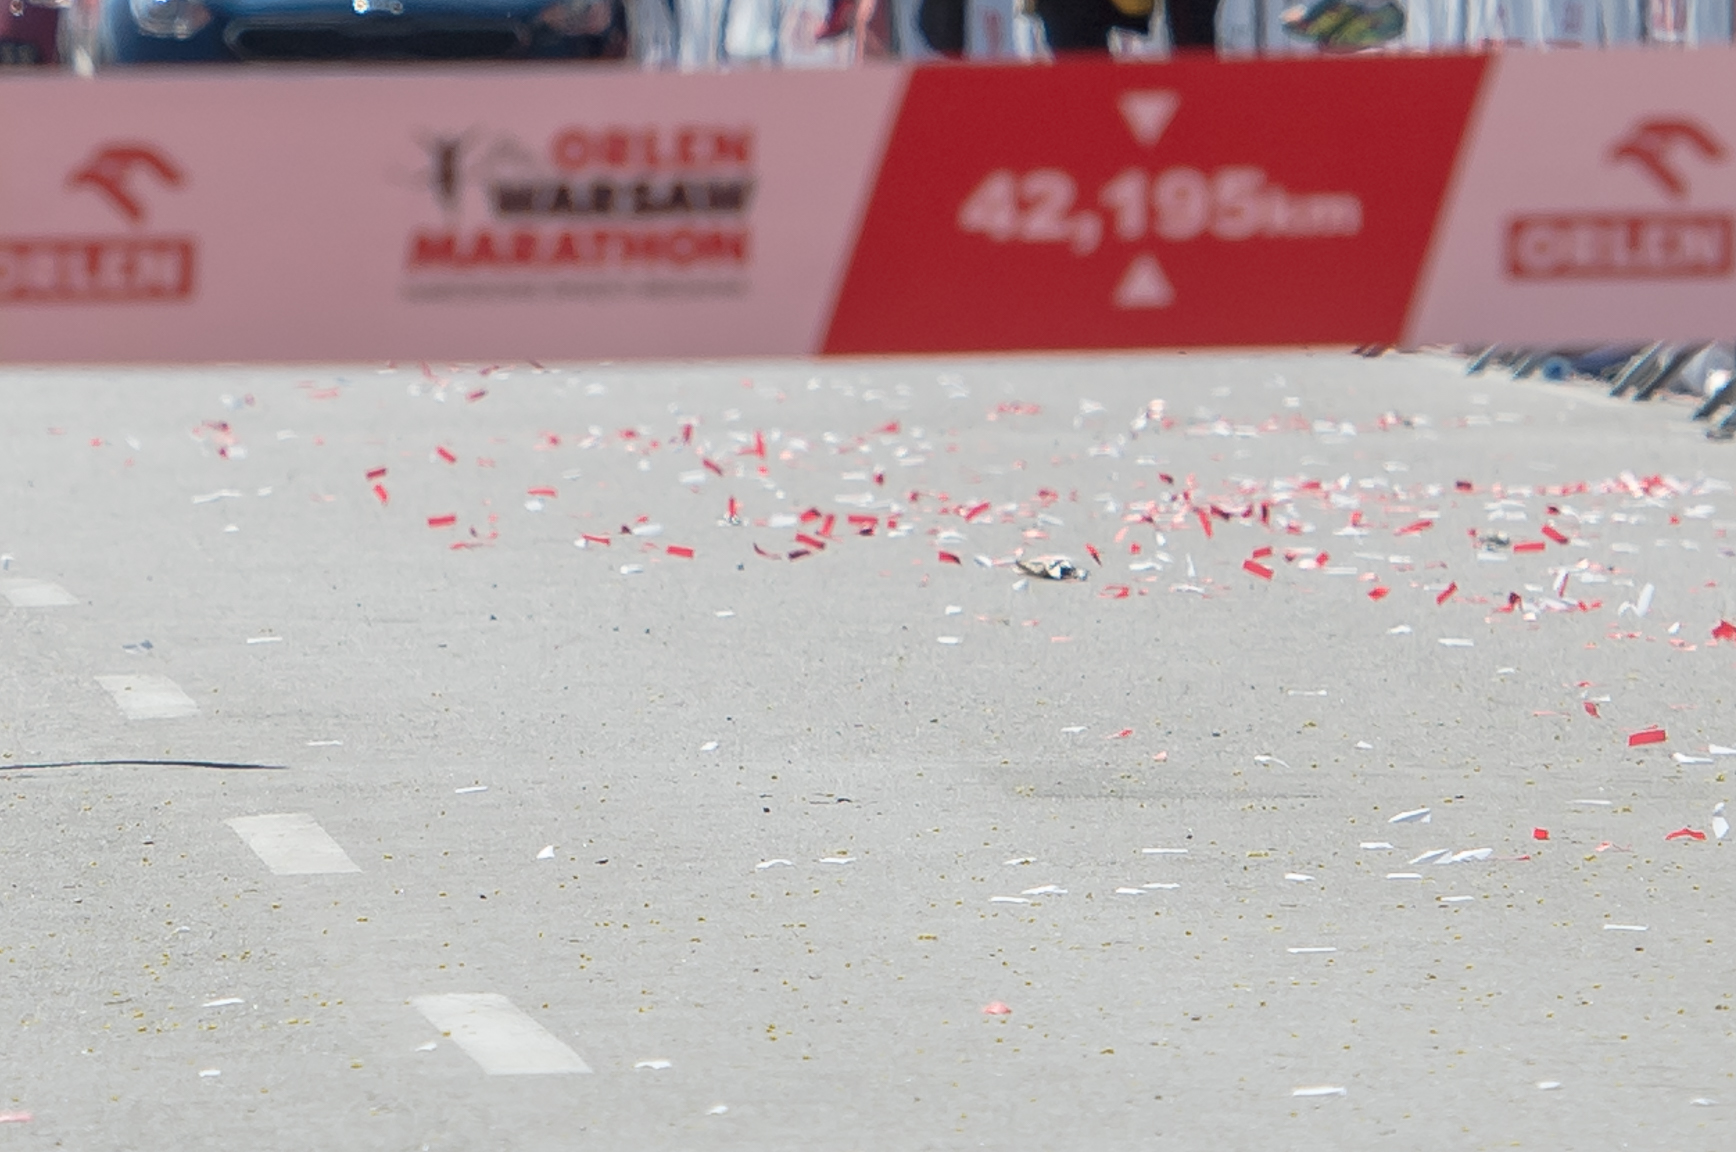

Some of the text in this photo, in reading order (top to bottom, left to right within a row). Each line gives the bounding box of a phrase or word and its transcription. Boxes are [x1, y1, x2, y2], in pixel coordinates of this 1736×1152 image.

[550, 125, 753, 171] ORLEN
[488, 180, 755, 218] WARSAW
[402, 226, 752, 271] MARATHON
[1517, 220, 1720, 272] ORLEN
